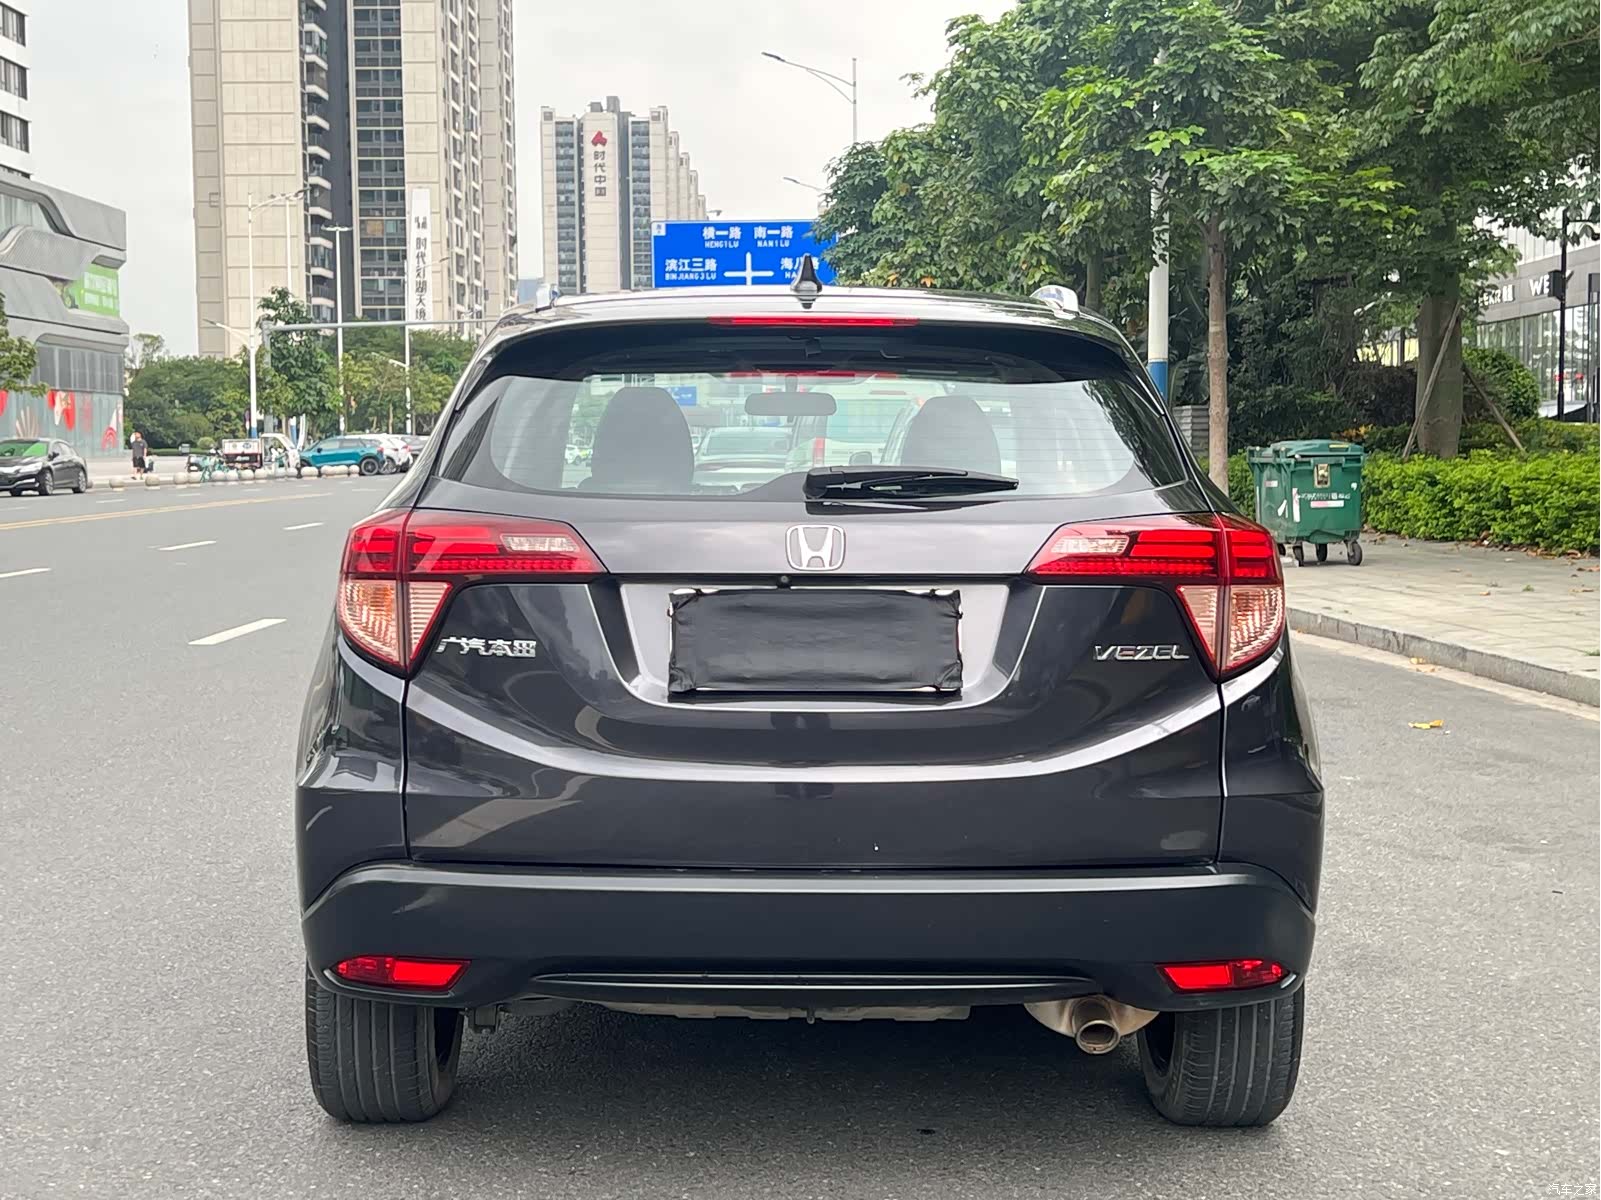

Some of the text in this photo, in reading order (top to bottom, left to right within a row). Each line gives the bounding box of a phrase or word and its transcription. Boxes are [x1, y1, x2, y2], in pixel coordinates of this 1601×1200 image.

[593, 150, 607, 197] 时代中国
[702, 226, 741, 240] 横一路
[754, 226, 793, 239] 南一路
[664, 257, 718, 272] 滨江三路
[435, 636, 537, 658] 广汽本田
[1094, 644, 1190, 661] VEZEL
